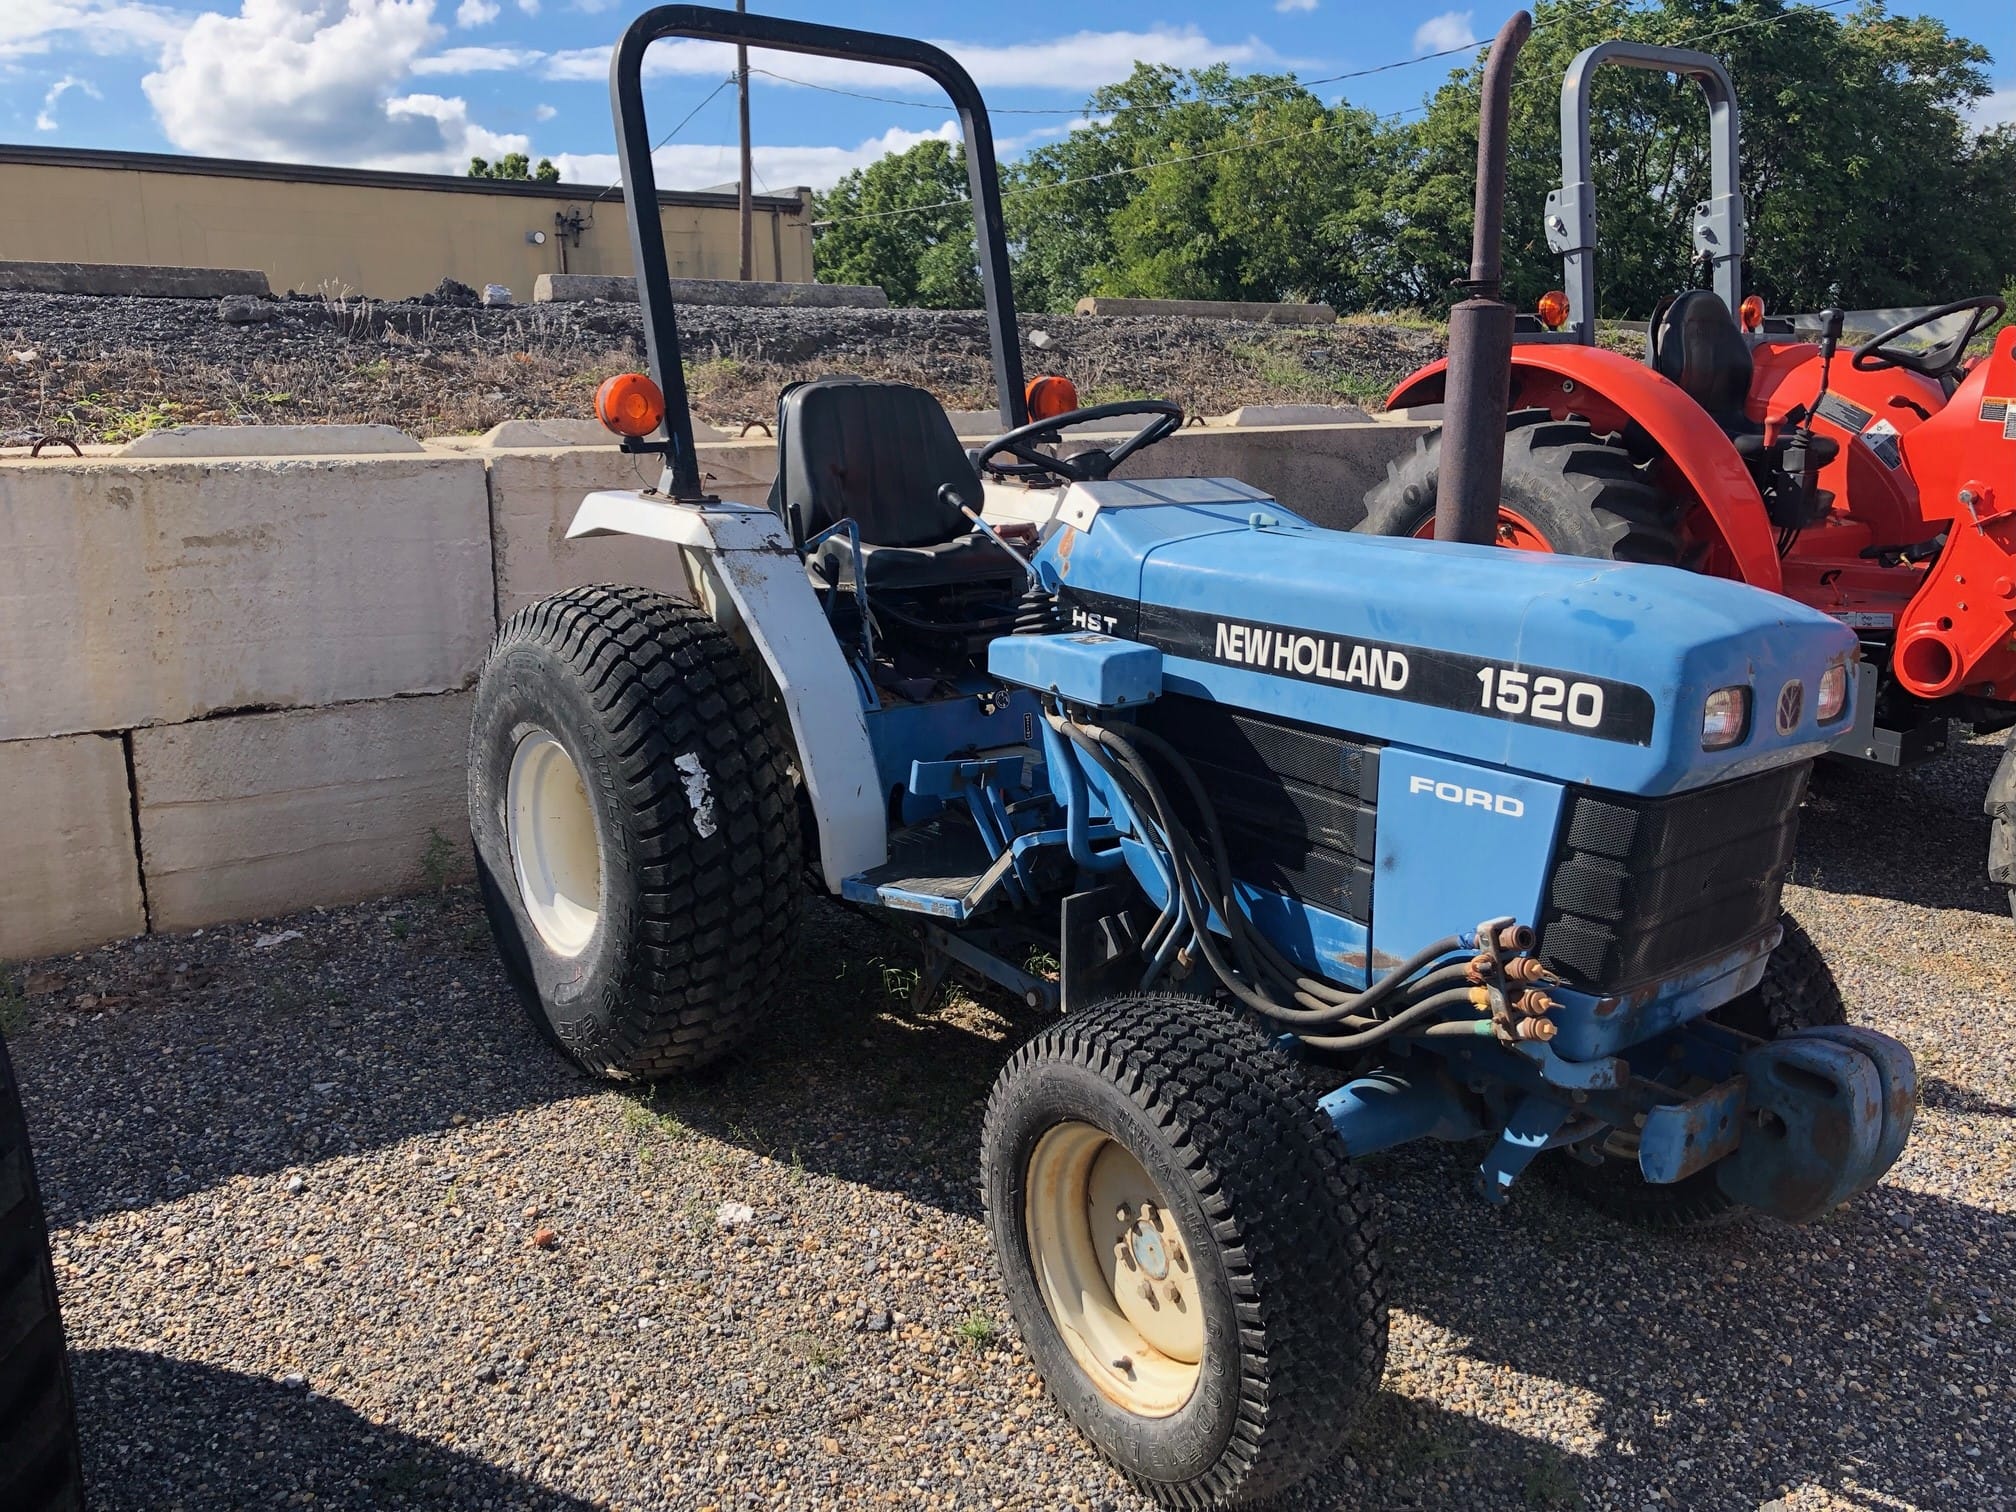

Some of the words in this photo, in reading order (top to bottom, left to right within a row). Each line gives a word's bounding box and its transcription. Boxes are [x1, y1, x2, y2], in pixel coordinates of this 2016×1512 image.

[1072, 606, 1118, 634] HST
[1215, 622, 1272, 666] NEW
[1273, 632, 1409, 691] HOLLAND
[1477, 667, 1604, 728] 1520
[579, 723, 630, 873] MULTI
[1410, 776, 1525, 817] FORD
